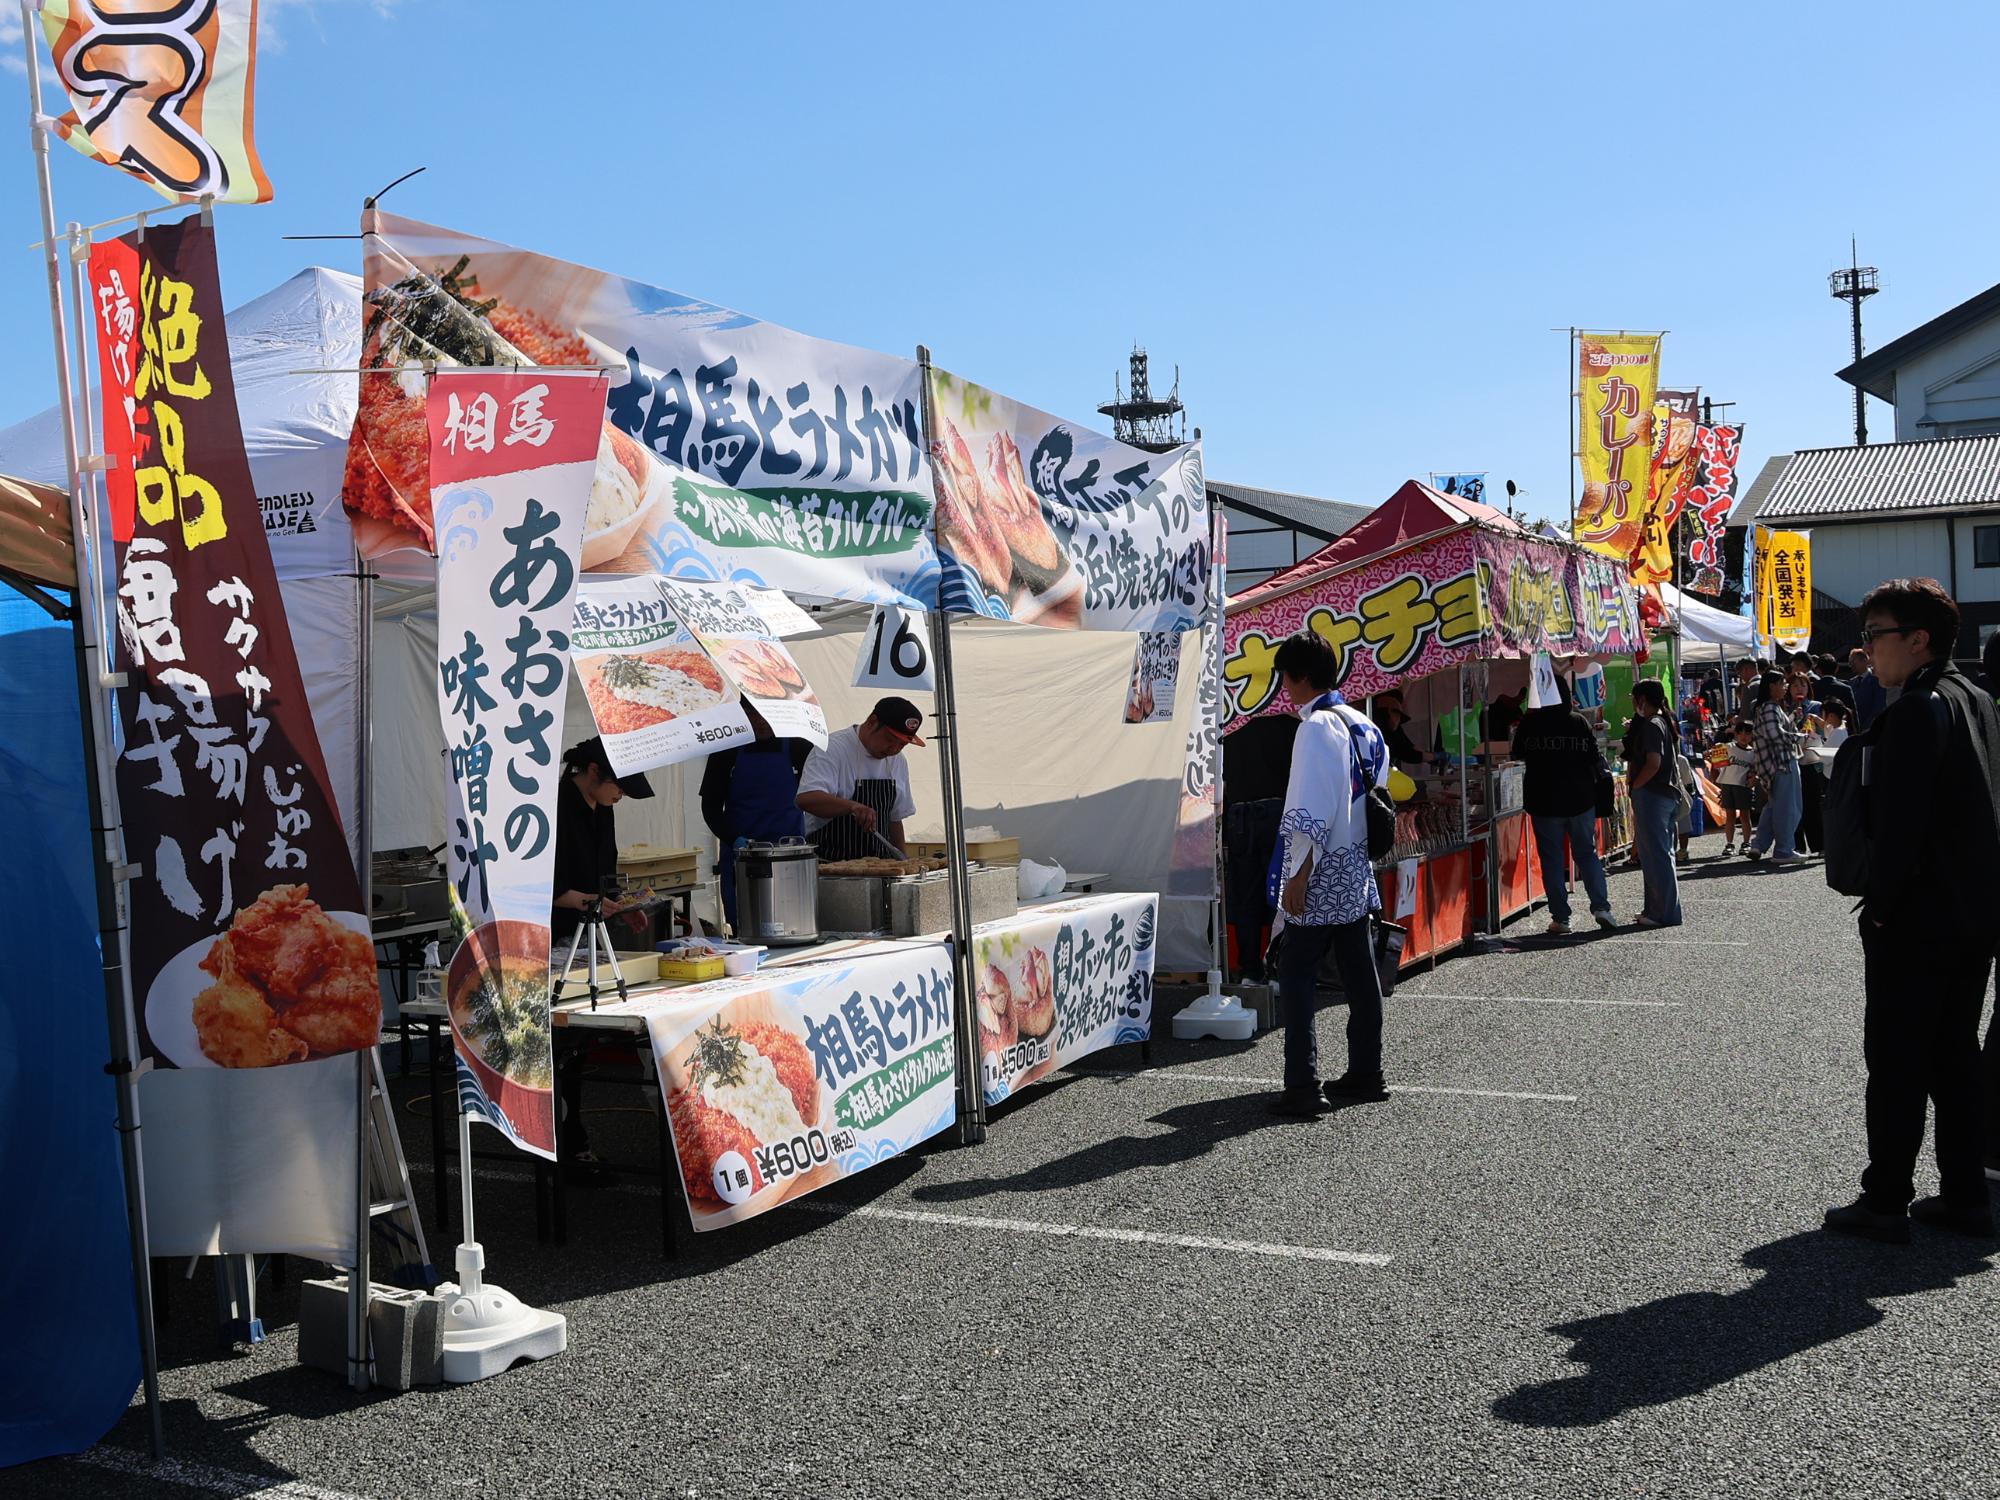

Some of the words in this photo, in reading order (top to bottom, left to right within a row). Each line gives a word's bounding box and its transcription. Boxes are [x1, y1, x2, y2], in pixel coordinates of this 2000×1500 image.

[442, 383, 559, 457] 相馬
[1582, 377, 1638, 543] カレーパン
[266, 510, 298, 530] ASE
[490, 498, 575, 862] あおさの
[869, 611, 926, 678] 16
[118, 537, 248, 925] 唐揚げ
[440, 629, 499, 914] 味噌汁
[1056, 943, 1070, 997] 相馬
[1072, 913, 1131, 991] ホッキの
[718, 1166, 749, 1192] 1個
[755, 1129, 828, 1184] ¥600
